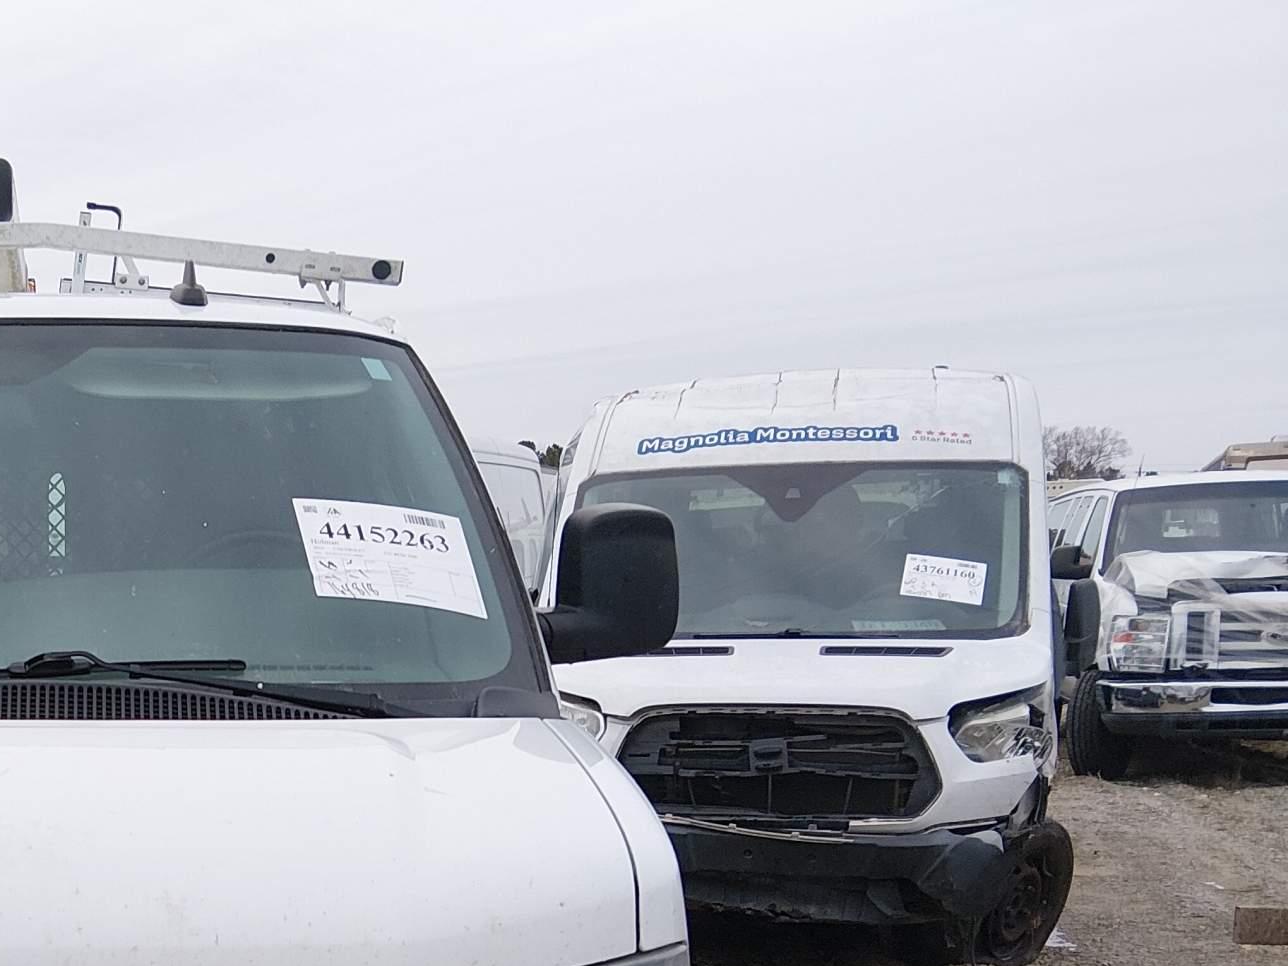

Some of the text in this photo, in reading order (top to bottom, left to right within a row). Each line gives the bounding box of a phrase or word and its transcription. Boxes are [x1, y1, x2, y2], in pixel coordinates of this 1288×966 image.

[641, 426, 895, 453] Magnolia Montessori
[920, 435, 941, 443] Star
[319, 521, 450, 553] 44152263
[912, 563, 976, 579] 43761160
